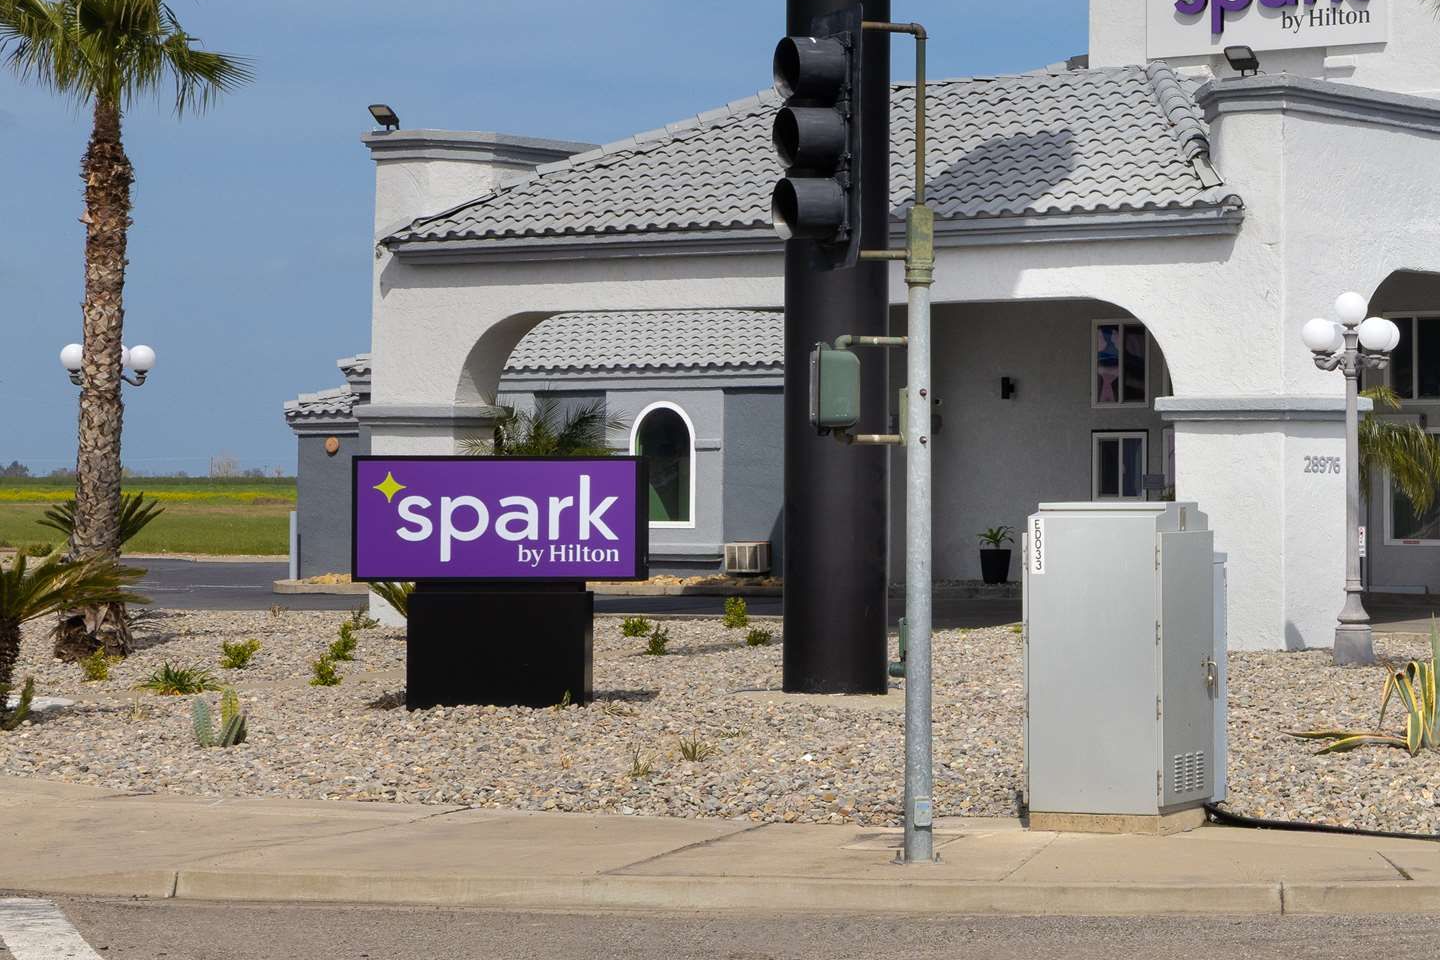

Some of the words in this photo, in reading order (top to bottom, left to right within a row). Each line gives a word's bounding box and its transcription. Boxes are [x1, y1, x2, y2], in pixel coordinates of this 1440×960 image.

[1281, 10, 1305, 34] by
[1308, 6, 1371, 28] Hilton
[1303, 455, 1341, 474] 28976
[396, 474, 620, 563] spark
[517, 544, 544, 568] by
[549, 544, 620, 563] Hilton
